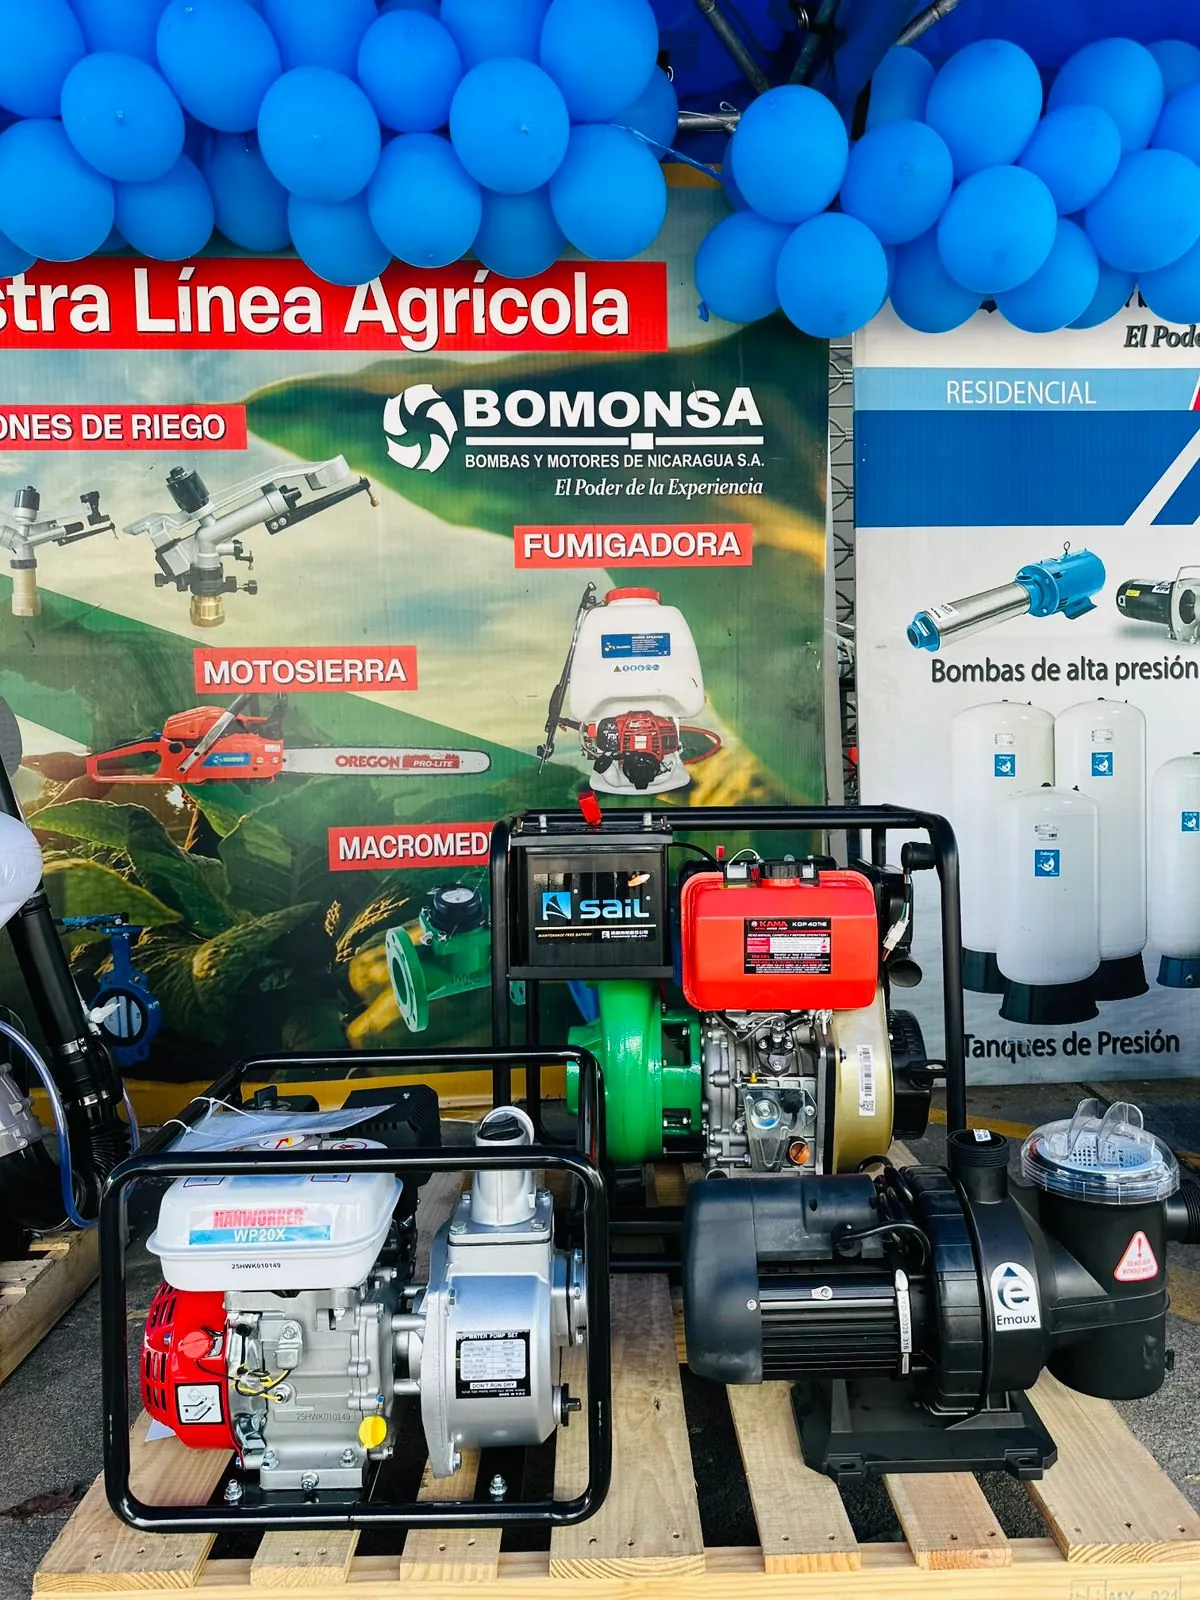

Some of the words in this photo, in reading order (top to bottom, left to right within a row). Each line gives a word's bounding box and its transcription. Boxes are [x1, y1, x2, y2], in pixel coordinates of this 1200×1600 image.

[0, 272, 111, 333] tra
[134, 266, 323, 334] Línea
[344, 269, 630, 353] Agrícola
[1124, 324, 1147, 348] El
[947, 379, 1098, 405] RESIDENCIAL
[463, 387, 764, 429] BOMONSA
[81, 413, 124, 440] DE
[131, 413, 226, 440] RIEGO
[464, 454, 530, 468] BOMBAS
[533, 455, 544, 468] Y
[547, 454, 620, 468] MOTORES
[623, 454, 644, 467] DE
[647, 453, 734, 468] NICARAGUA
[737, 453, 765, 467] S.A.
[555, 479, 571, 496] El
[574, 478, 624, 497] Poder
[626, 478, 646, 496] de
[648, 478, 665, 496] la
[667, 477, 764, 500] Experiencia
[523, 531, 741, 560] FUMIGADORA
[203, 658, 407, 685] MOTOSIERRA
[931, 657, 1026, 683] Bombas
[1031, 657, 1061, 682] de
[1067, 656, 1109, 682] alta
[1115, 655, 1199, 686] presión
[335, 754, 401, 768] OREGON
[413, 759, 454, 769] PRO-LITE
[963, 1033, 1057, 1064] Tanques
[1062, 1031, 1092, 1057] de
[1097, 1028, 1180, 1055] Presión
[213, 1208, 305, 1228] HANWORKER
[233, 1228, 286, 1242] WP20X
[231, 1262, 281, 1270] 25HWK010149
[997, 1314, 1037, 1326] Emaux
[296, 1412, 351, 1422] 25HWK010149
